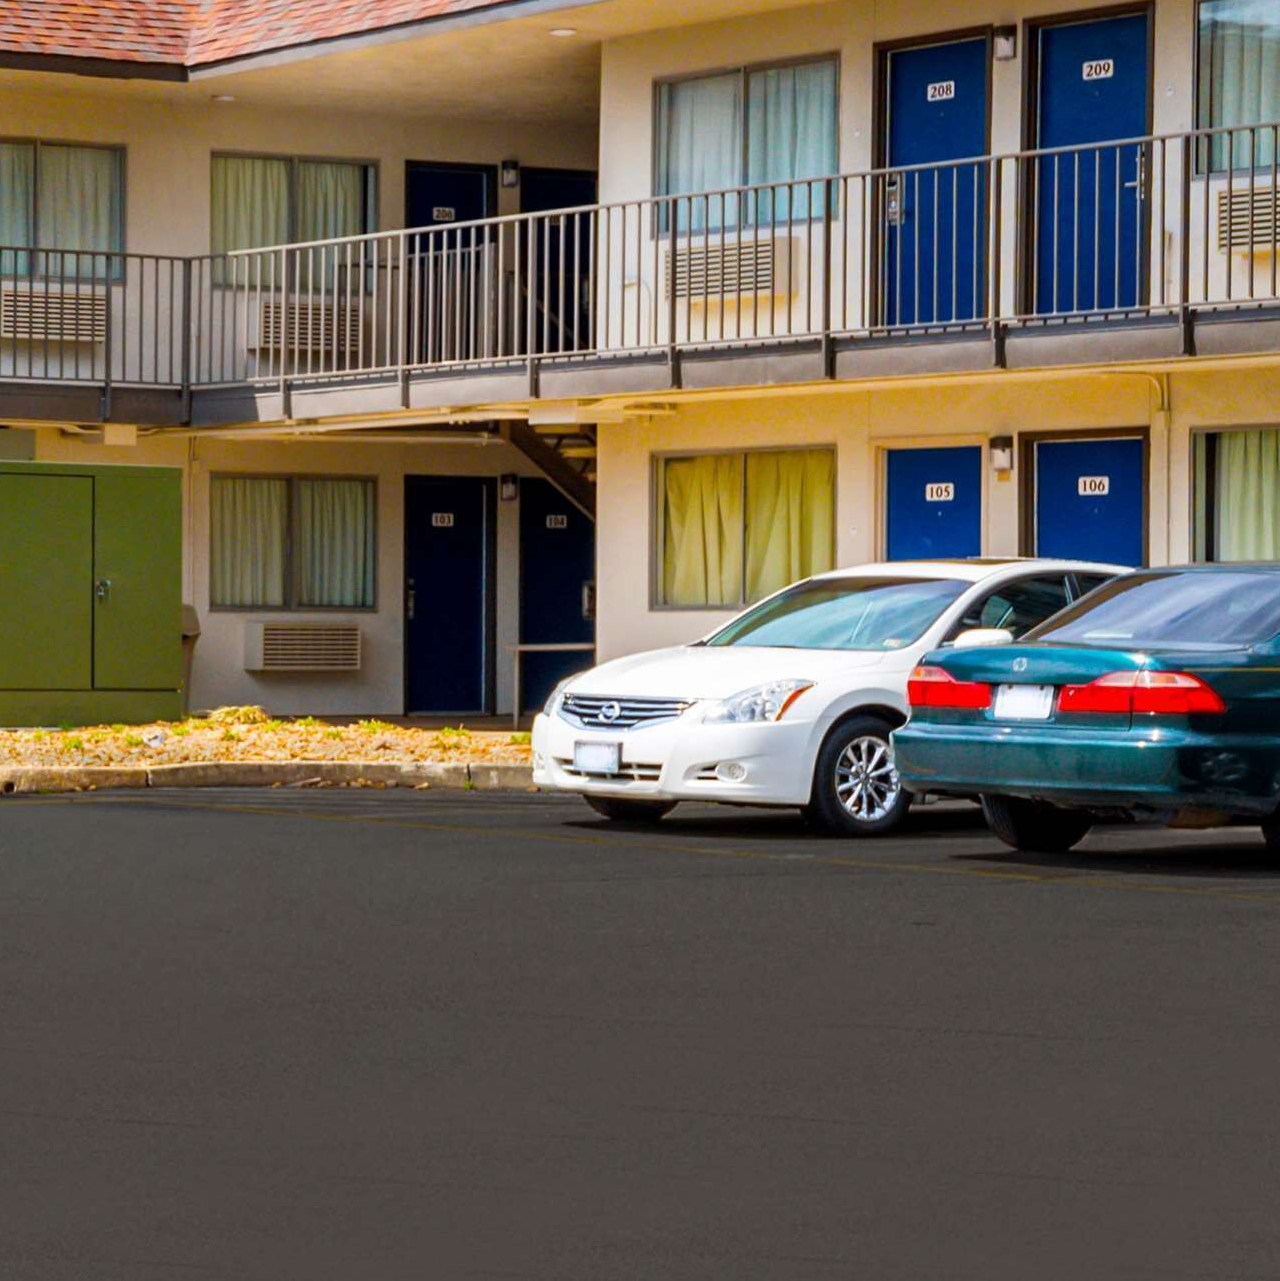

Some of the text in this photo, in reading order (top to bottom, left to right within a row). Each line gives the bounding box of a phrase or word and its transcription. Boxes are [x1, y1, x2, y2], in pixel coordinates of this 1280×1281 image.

[1086, 61, 1111, 77] 209
[930, 82, 953, 98] 208
[930, 485, 950, 498] 105
[1082, 478, 1106, 492] 106
[434, 514, 451, 526] 103
